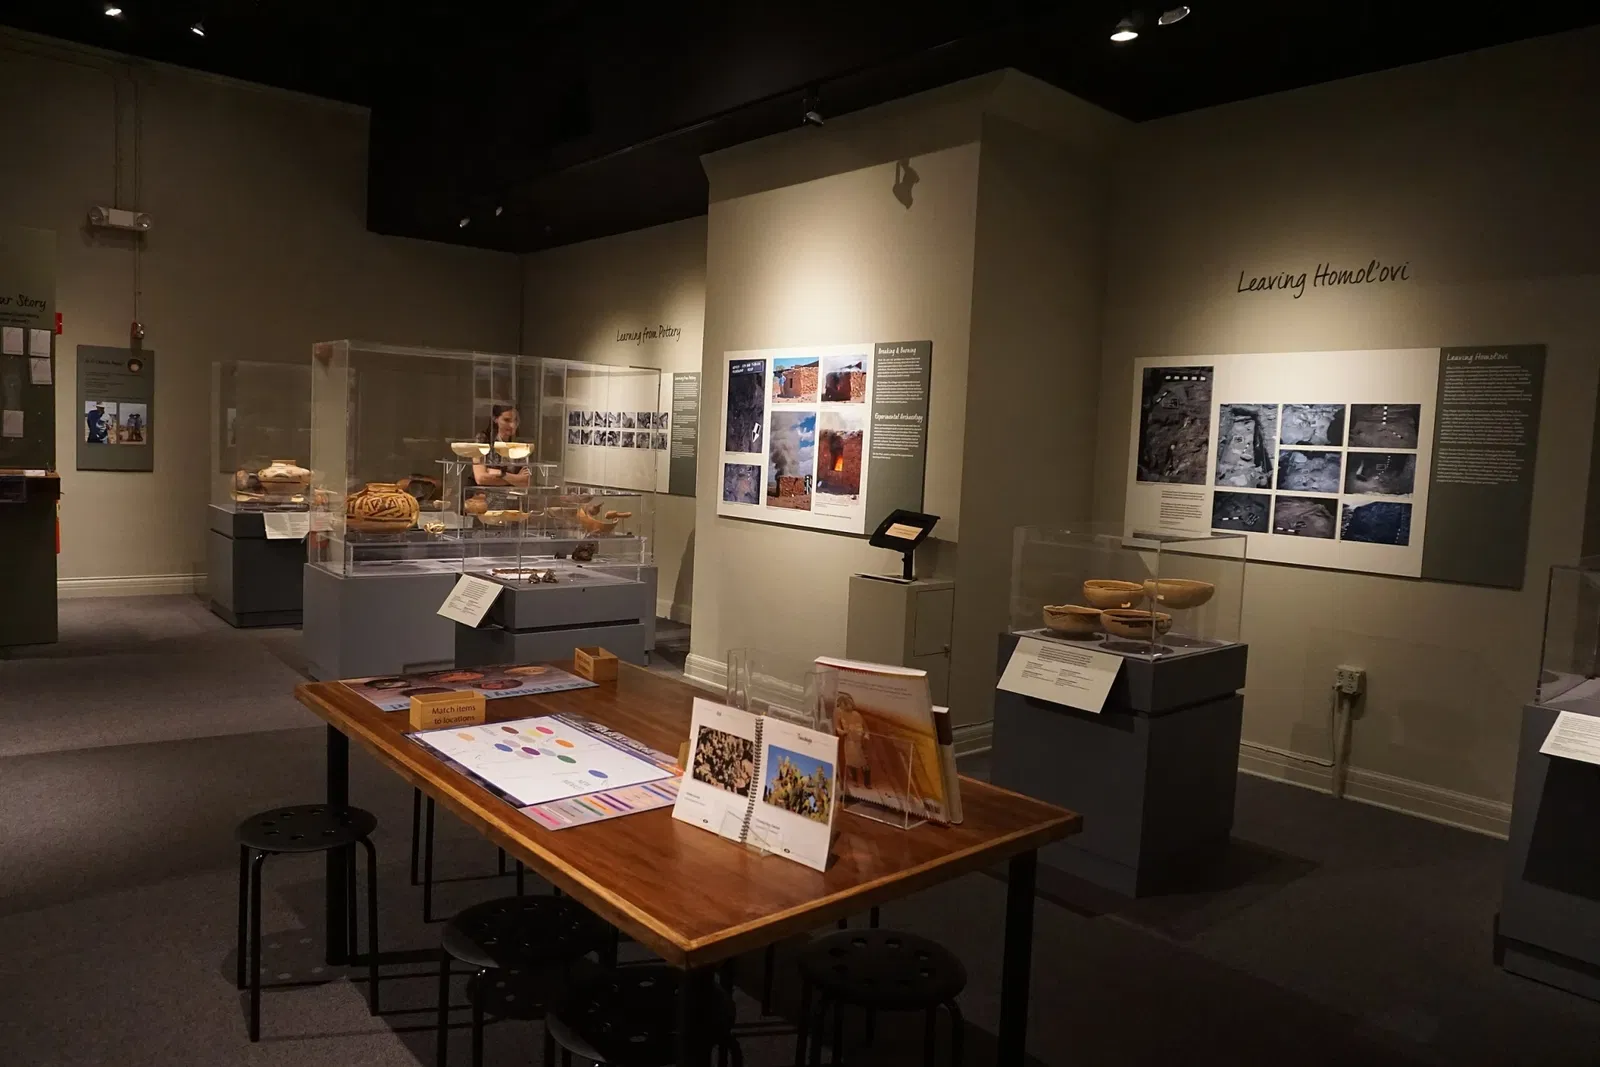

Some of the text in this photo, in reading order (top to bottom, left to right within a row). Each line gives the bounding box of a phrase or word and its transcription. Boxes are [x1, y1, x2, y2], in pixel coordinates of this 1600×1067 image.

[1237, 259, 1410, 299] Leaving Homol'ovi
[16, 292, 47, 313] Story
[616, 324, 682, 347] Learning from Pottery
[1446, 353, 1474, 364] Leaving
[431, 704, 476, 715] Match items
[434, 715, 475, 725] to locations
